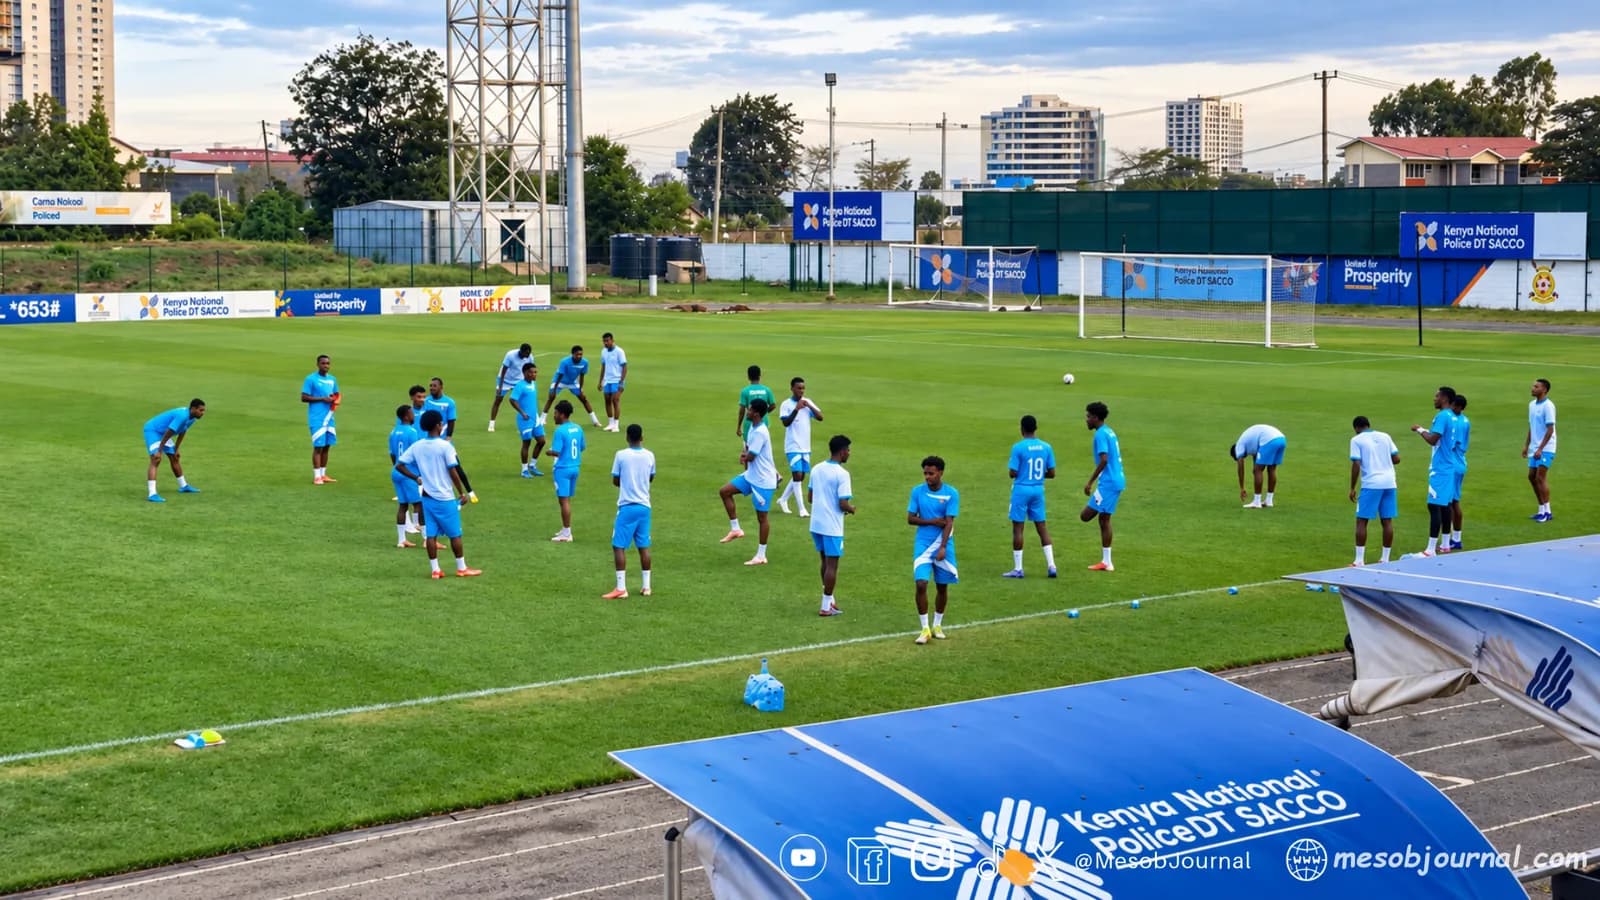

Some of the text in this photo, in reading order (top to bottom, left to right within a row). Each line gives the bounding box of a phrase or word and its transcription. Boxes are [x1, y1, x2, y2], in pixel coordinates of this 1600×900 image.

[852, 218, 877, 228] SACCO
[1444, 224, 1519, 238] Kenya National
[1444, 238, 1526, 250] Police DT SACCO
[1344, 268, 1412, 288] Prosperity
[163, 296, 225, 308] Kenya National
[314, 297, 367, 312] Prosperity
[163, 307, 188, 317] Police
[188, 307, 199, 316] DT
[200, 306, 230, 316] SACCO
[571, 438, 578, 459] 6
[1027, 457, 1045, 481] 19
[1061, 768, 1320, 834] Kenya National
[1234, 789, 1348, 829] SACCO
